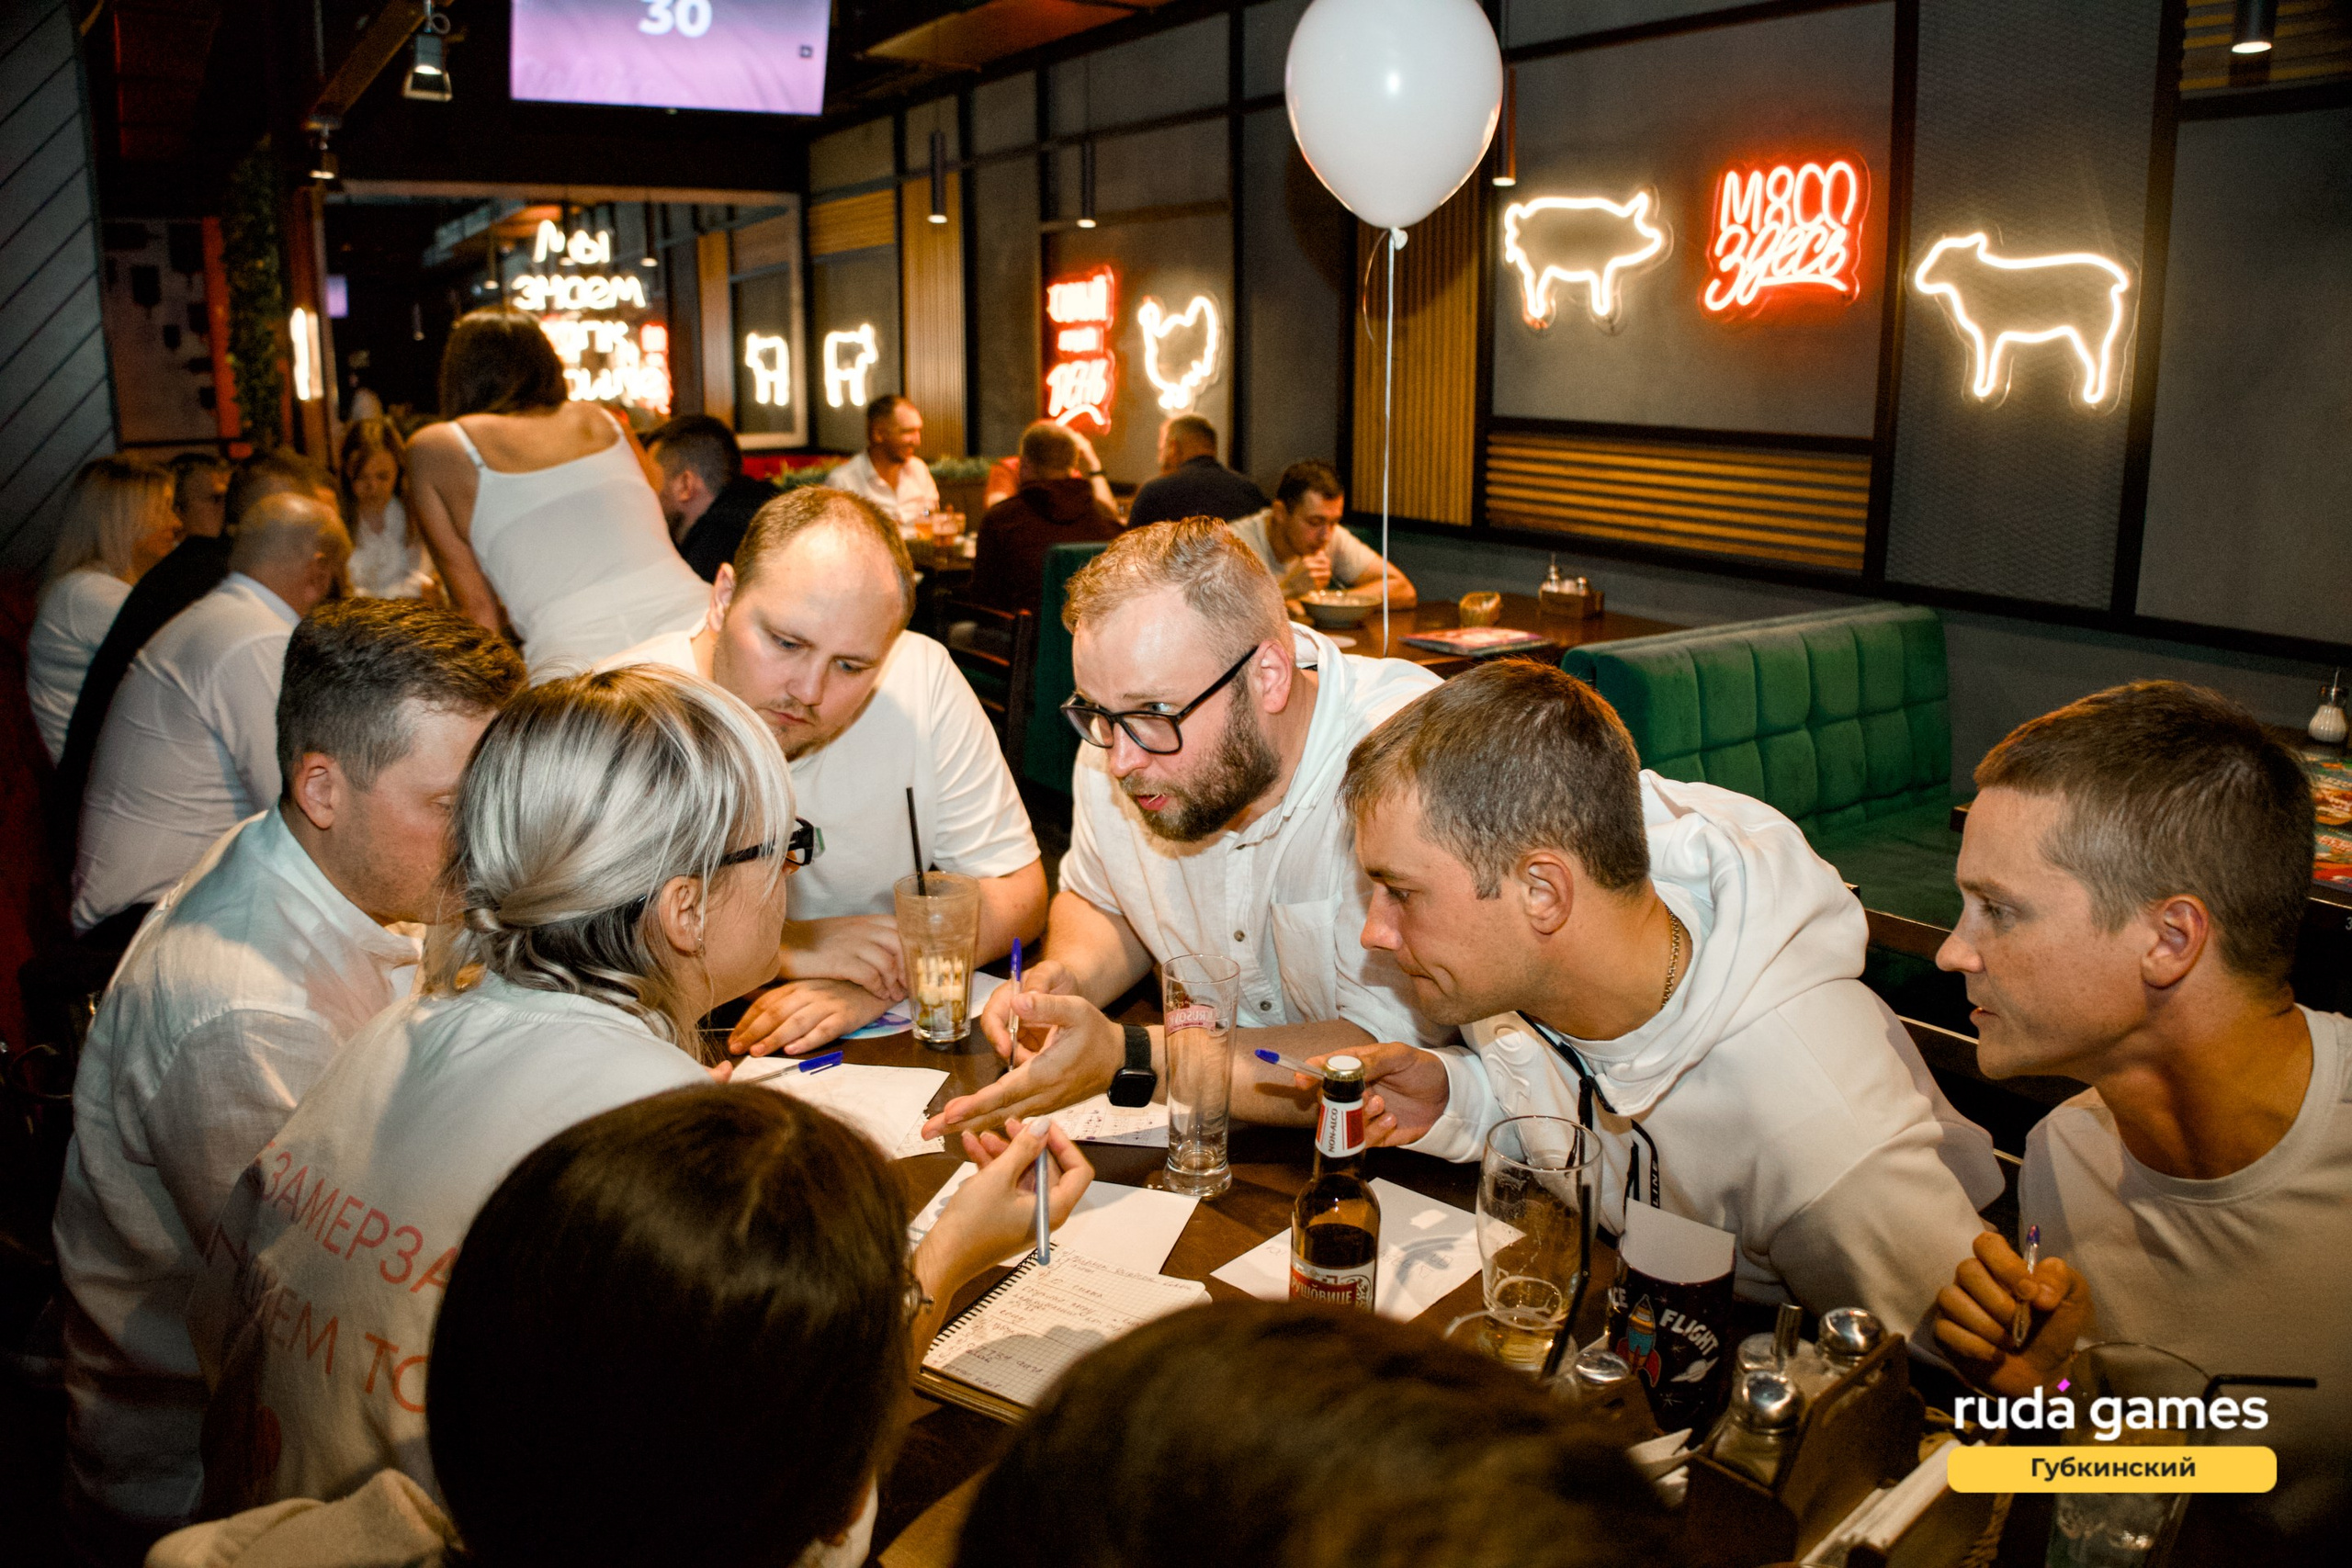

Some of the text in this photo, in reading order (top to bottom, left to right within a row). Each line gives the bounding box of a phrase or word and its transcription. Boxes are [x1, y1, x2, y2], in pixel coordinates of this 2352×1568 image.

[639, 0, 712, 38] 30
[1328, 1108, 1339, 1153] NON-ALCO
[1659, 1308, 1720, 1357] FLIGHT
